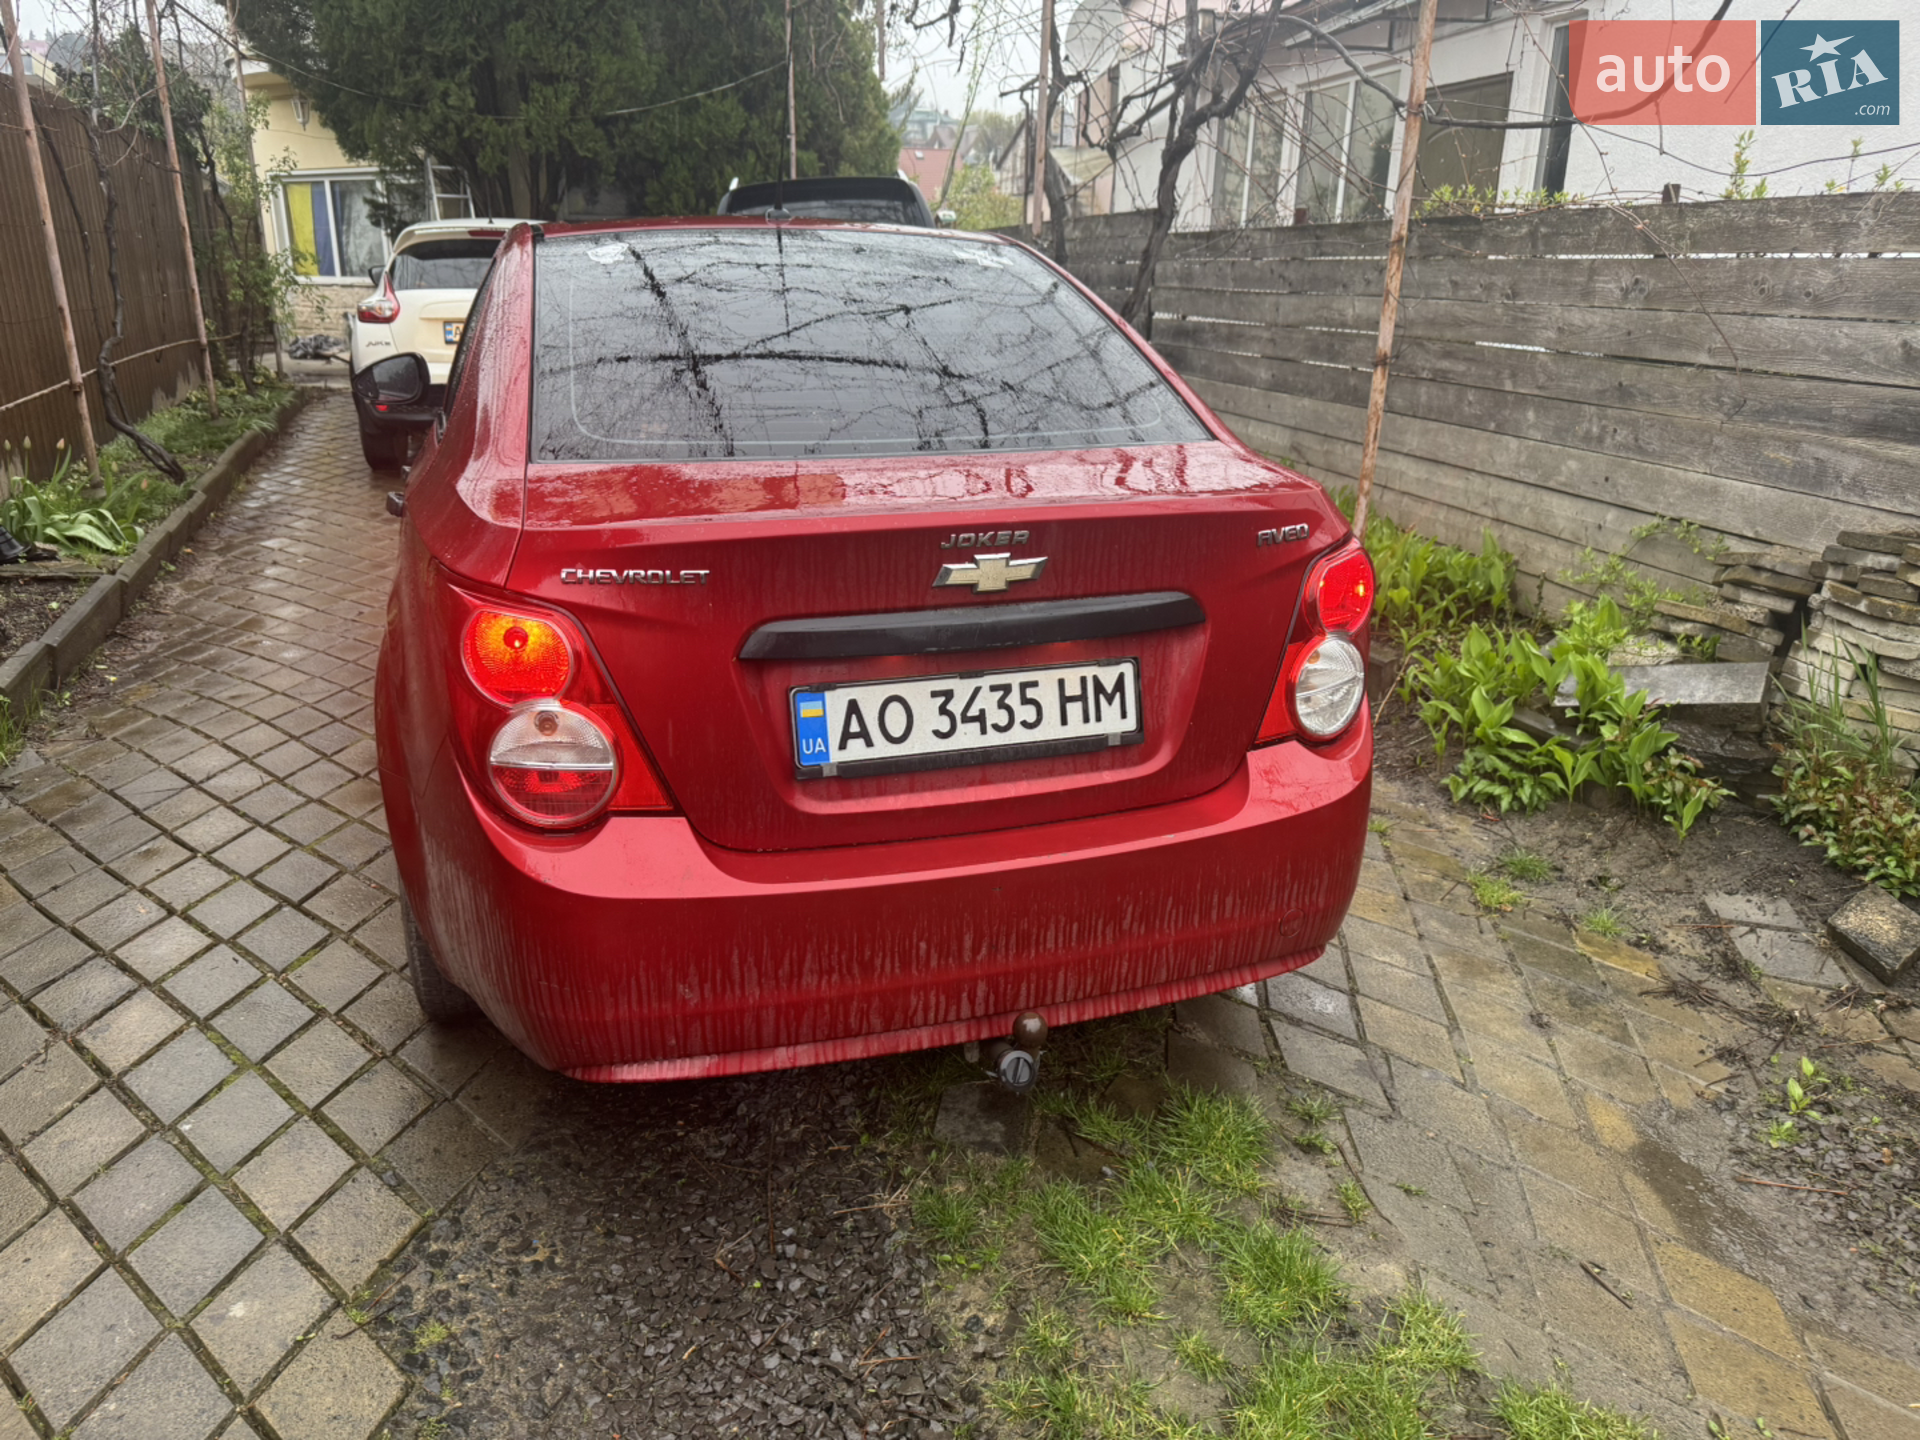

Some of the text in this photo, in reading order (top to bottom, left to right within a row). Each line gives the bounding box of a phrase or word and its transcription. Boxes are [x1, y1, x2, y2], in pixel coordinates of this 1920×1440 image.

[940, 530, 1030, 549] JOKER
[1257, 523, 1309, 546] AVEO
[560, 568, 710, 585] CHEVROLET
[838, 671, 1128, 751] AO 3435 HM
[802, 737, 827, 755] UA
